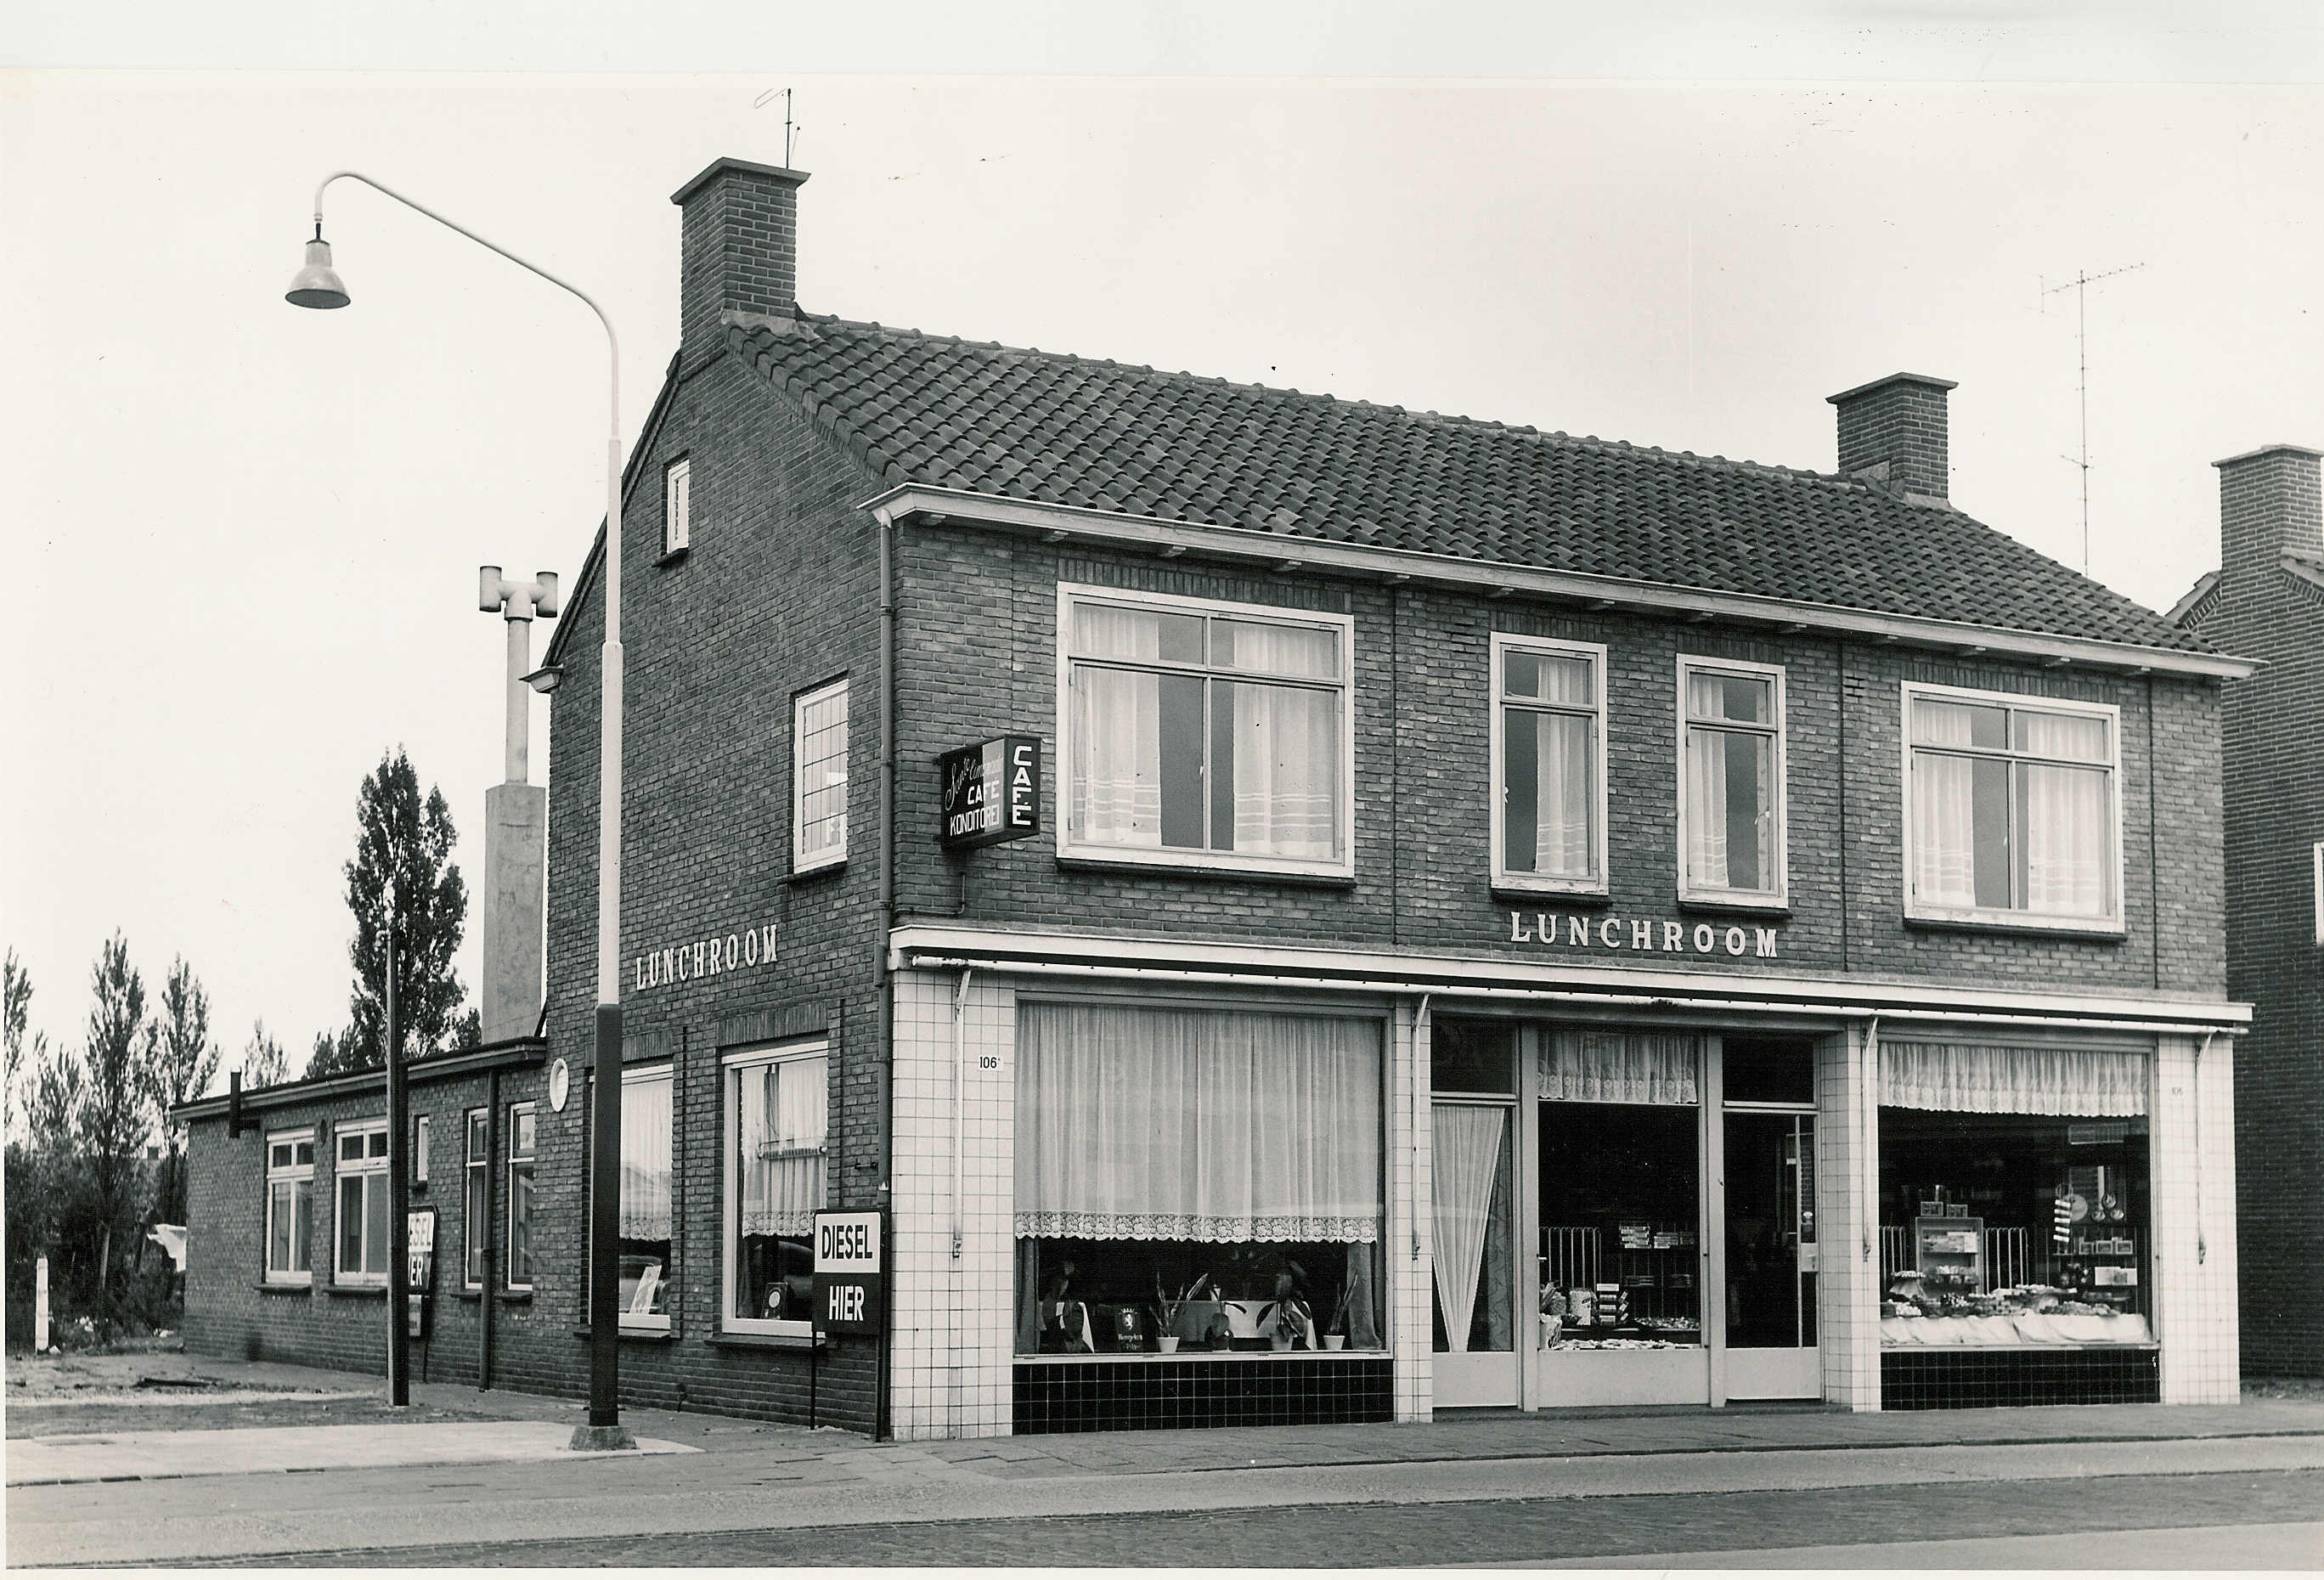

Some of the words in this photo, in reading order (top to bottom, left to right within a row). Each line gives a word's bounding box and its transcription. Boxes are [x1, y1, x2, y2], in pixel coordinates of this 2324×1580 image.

[1013, 745, 1032, 826] CAFÉ
[950, 803, 1000, 837] KONDITOREI
[1510, 911, 1778, 958] LUNCHROOM
[636, 923, 778, 991] LUNCHROOM
[821, 1224, 873, 1260] DIESEL
[828, 1285, 865, 1322] HIER
